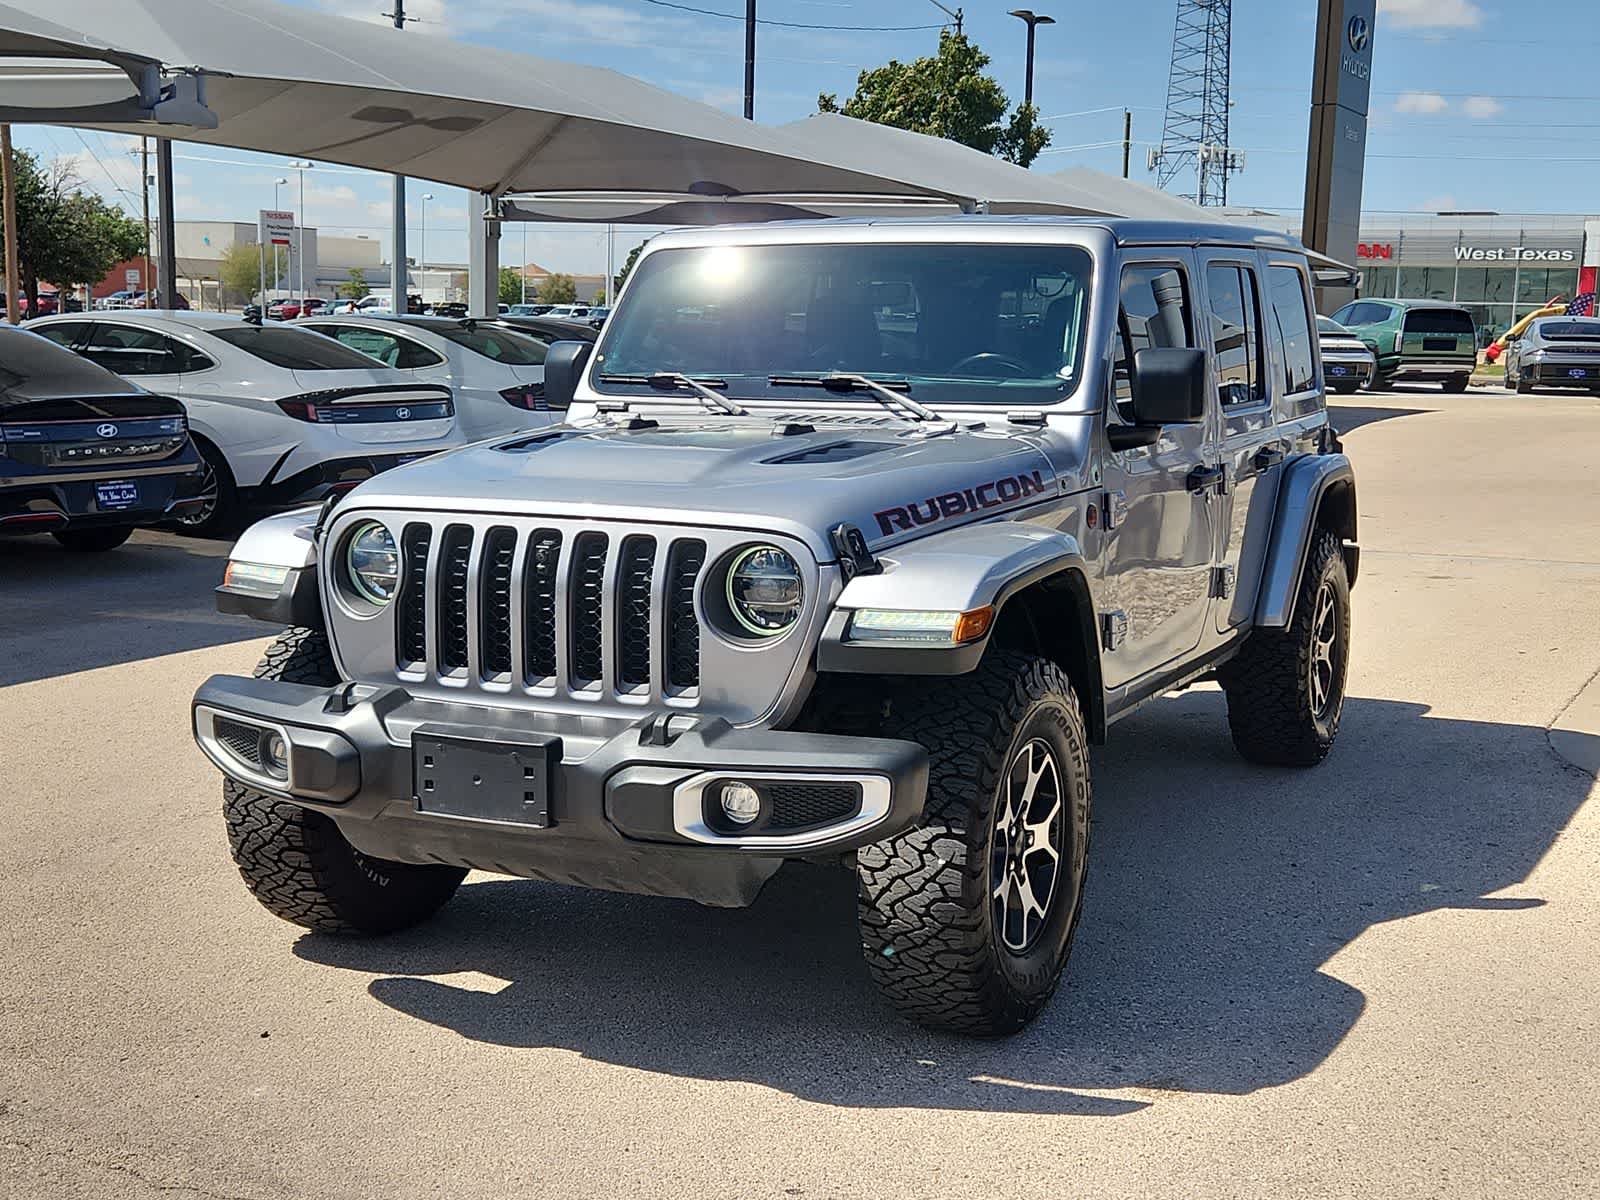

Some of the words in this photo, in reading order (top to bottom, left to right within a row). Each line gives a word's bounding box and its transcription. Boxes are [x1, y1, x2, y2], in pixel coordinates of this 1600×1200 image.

[1454, 246, 1505, 260] West
[1511, 246, 1574, 260] Texas
[67, 445, 152, 456] SONATA
[872, 470, 1046, 537] RUBICON
